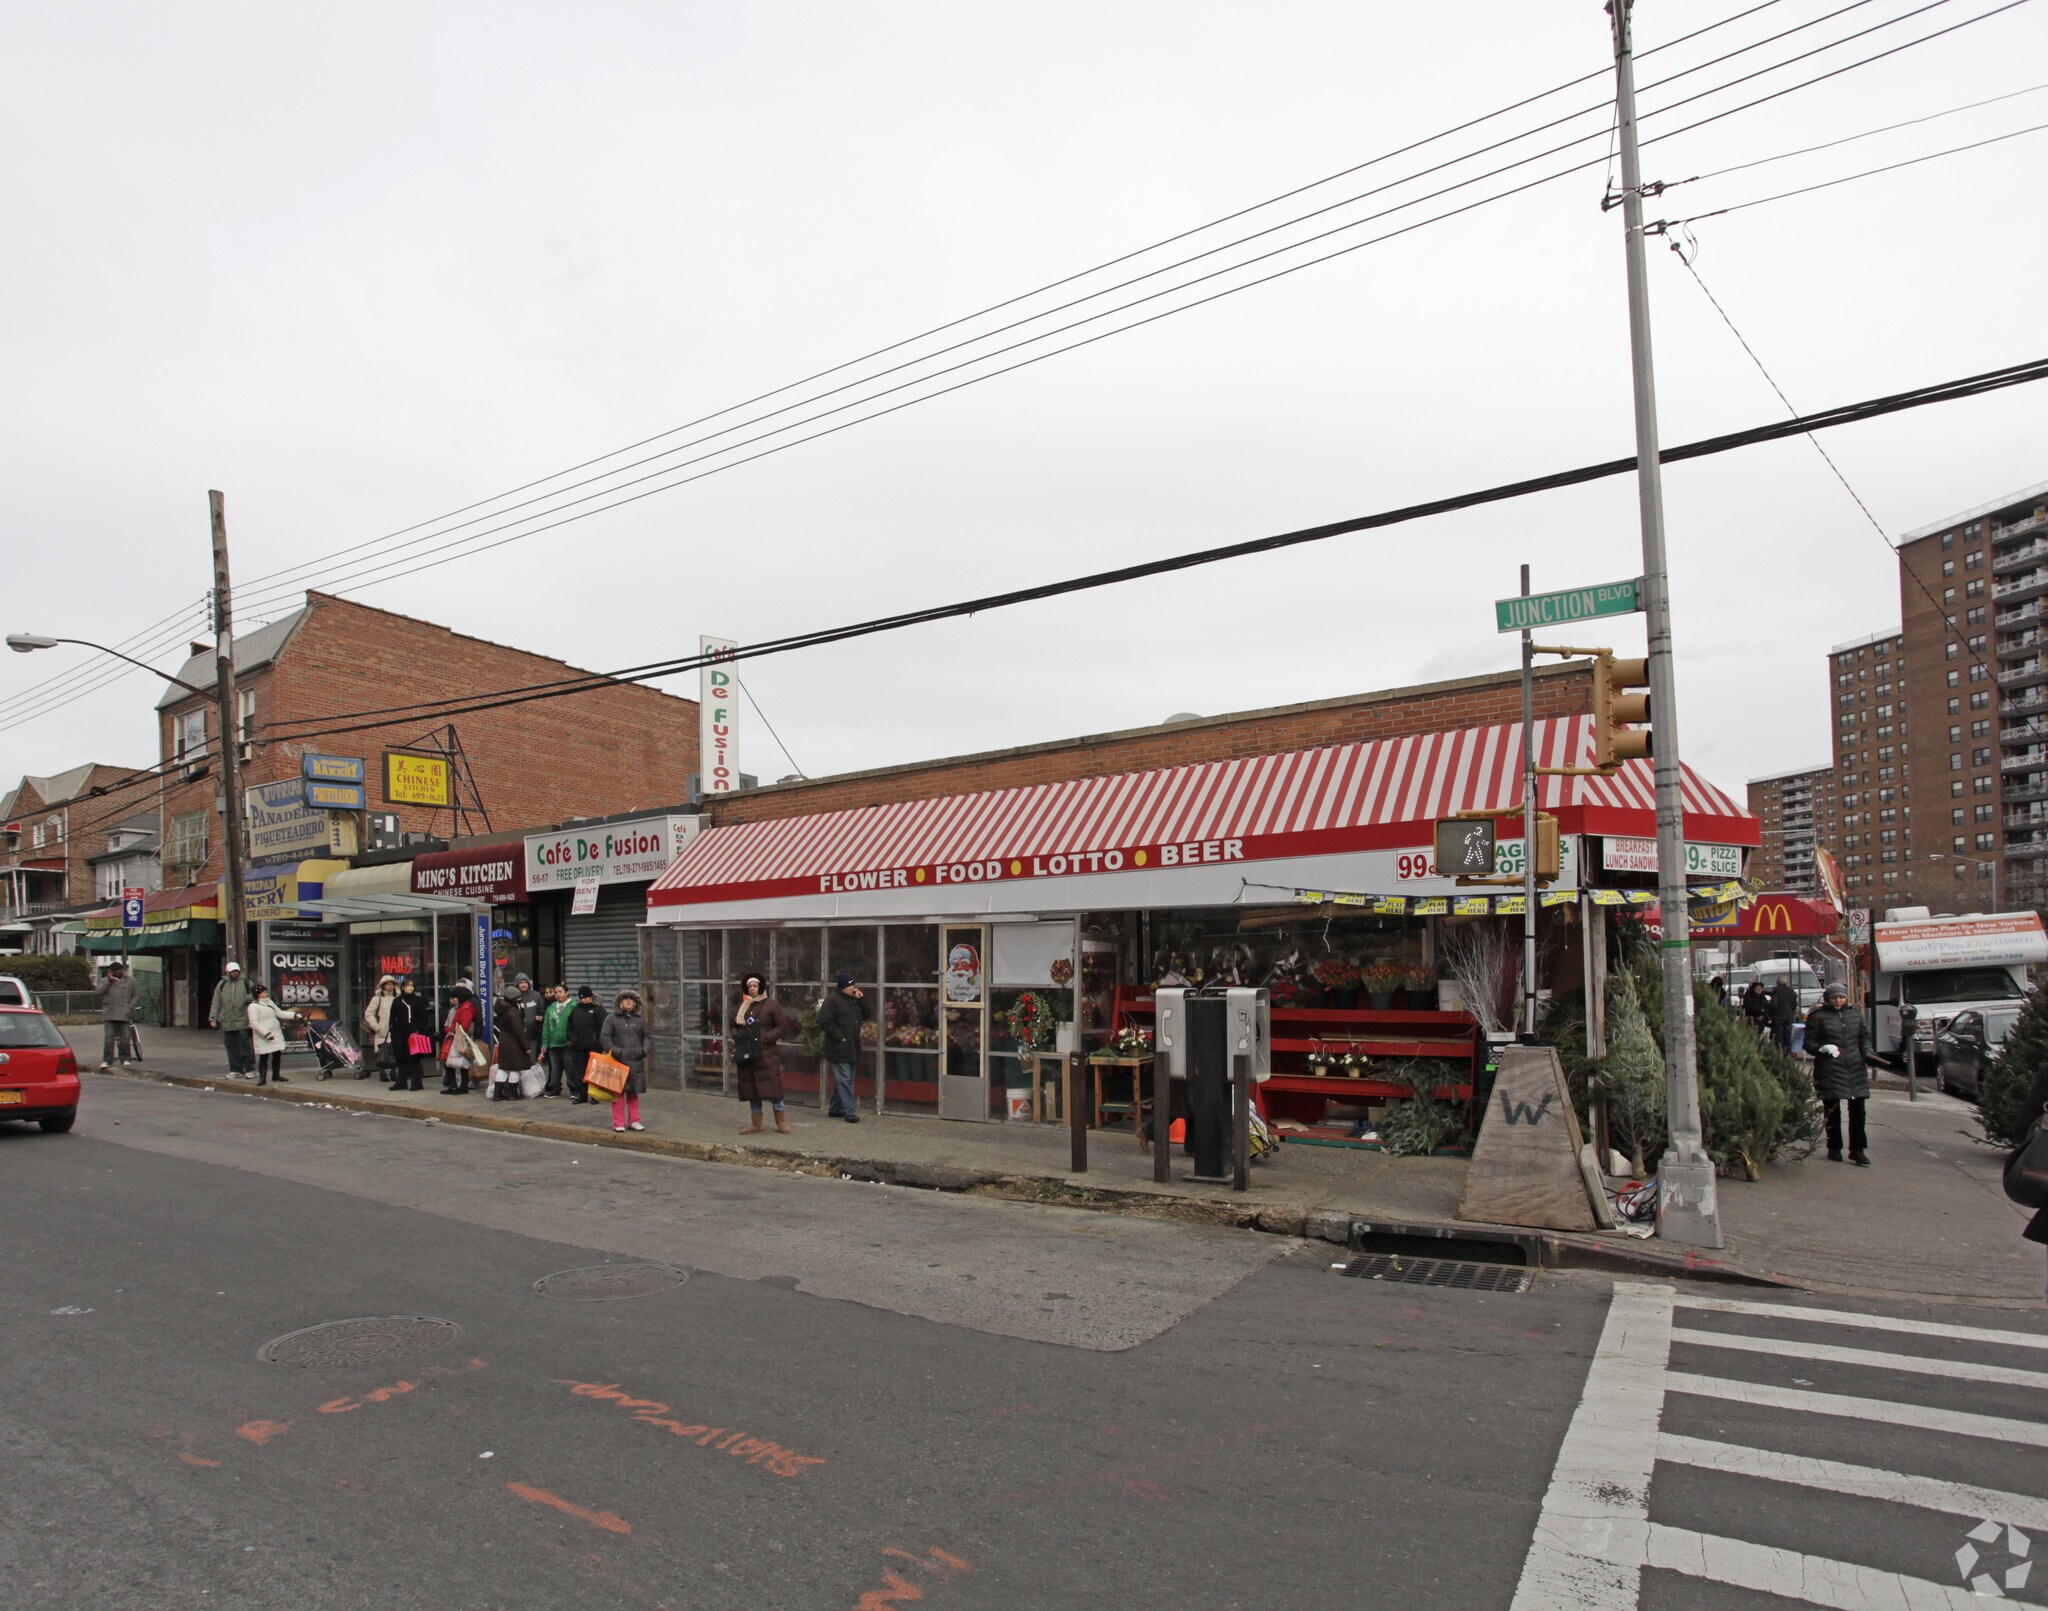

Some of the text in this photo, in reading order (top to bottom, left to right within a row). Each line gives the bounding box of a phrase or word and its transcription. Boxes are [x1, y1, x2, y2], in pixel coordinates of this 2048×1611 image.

[1504, 584, 1633, 628] JUNCTION BLVD
[711, 670, 730, 699] De
[712, 708, 730, 791] Fusion
[313, 759, 358, 778] BAKERY
[396, 774, 441, 787] CHINESE
[394, 790, 408, 799] Tel:
[403, 784, 436, 793] KITCHEN
[254, 820, 326, 846] PIQUETEADERO
[537, 838, 571, 865] Café
[577, 838, 599, 861] De
[605, 830, 660, 858] Fusion
[1615, 840, 1653, 855] BREAKFAST
[1711, 847, 1737, 860] PIZZA
[819, 838, 1244, 893] FLOWER FOOD LOTTO BEER
[1605, 854, 1659, 870] LUNCH SANDWIC
[1711, 860, 1737, 873] SLICE
[417, 861, 513, 889] MING'S KITCHEN
[556, 867, 573, 881] FREE
[573, 864, 604, 881] DELIVERY
[246, 882, 287, 908] KERY
[433, 884, 494, 897] CHINESE CUISINE
[576, 887, 597, 896] RENT
[1725, 885, 1740, 893] PLAY
[1726, 890, 1743, 899] HERE
[247, 907, 281, 918] TEADERO
[1910, 926, 1937, 934] Health
[1976, 922, 1997, 930] New
[1998, 919, 2035, 928] Yorkers
[1921, 931, 1963, 939] Medicare
[1973, 926, 2016, 935] Medicaid
[1966, 939, 1994, 948] Elite
[1994, 936, 2034, 947] (HMO)
[273, 953, 335, 968] QUEENS
[381, 954, 412, 974] NAILS
[1941, 957, 1962, 965] NOW!
[282, 984, 330, 1003] BBQ
[480, 987, 487, 997] 57
[1499, 1089, 1552, 1126] W
